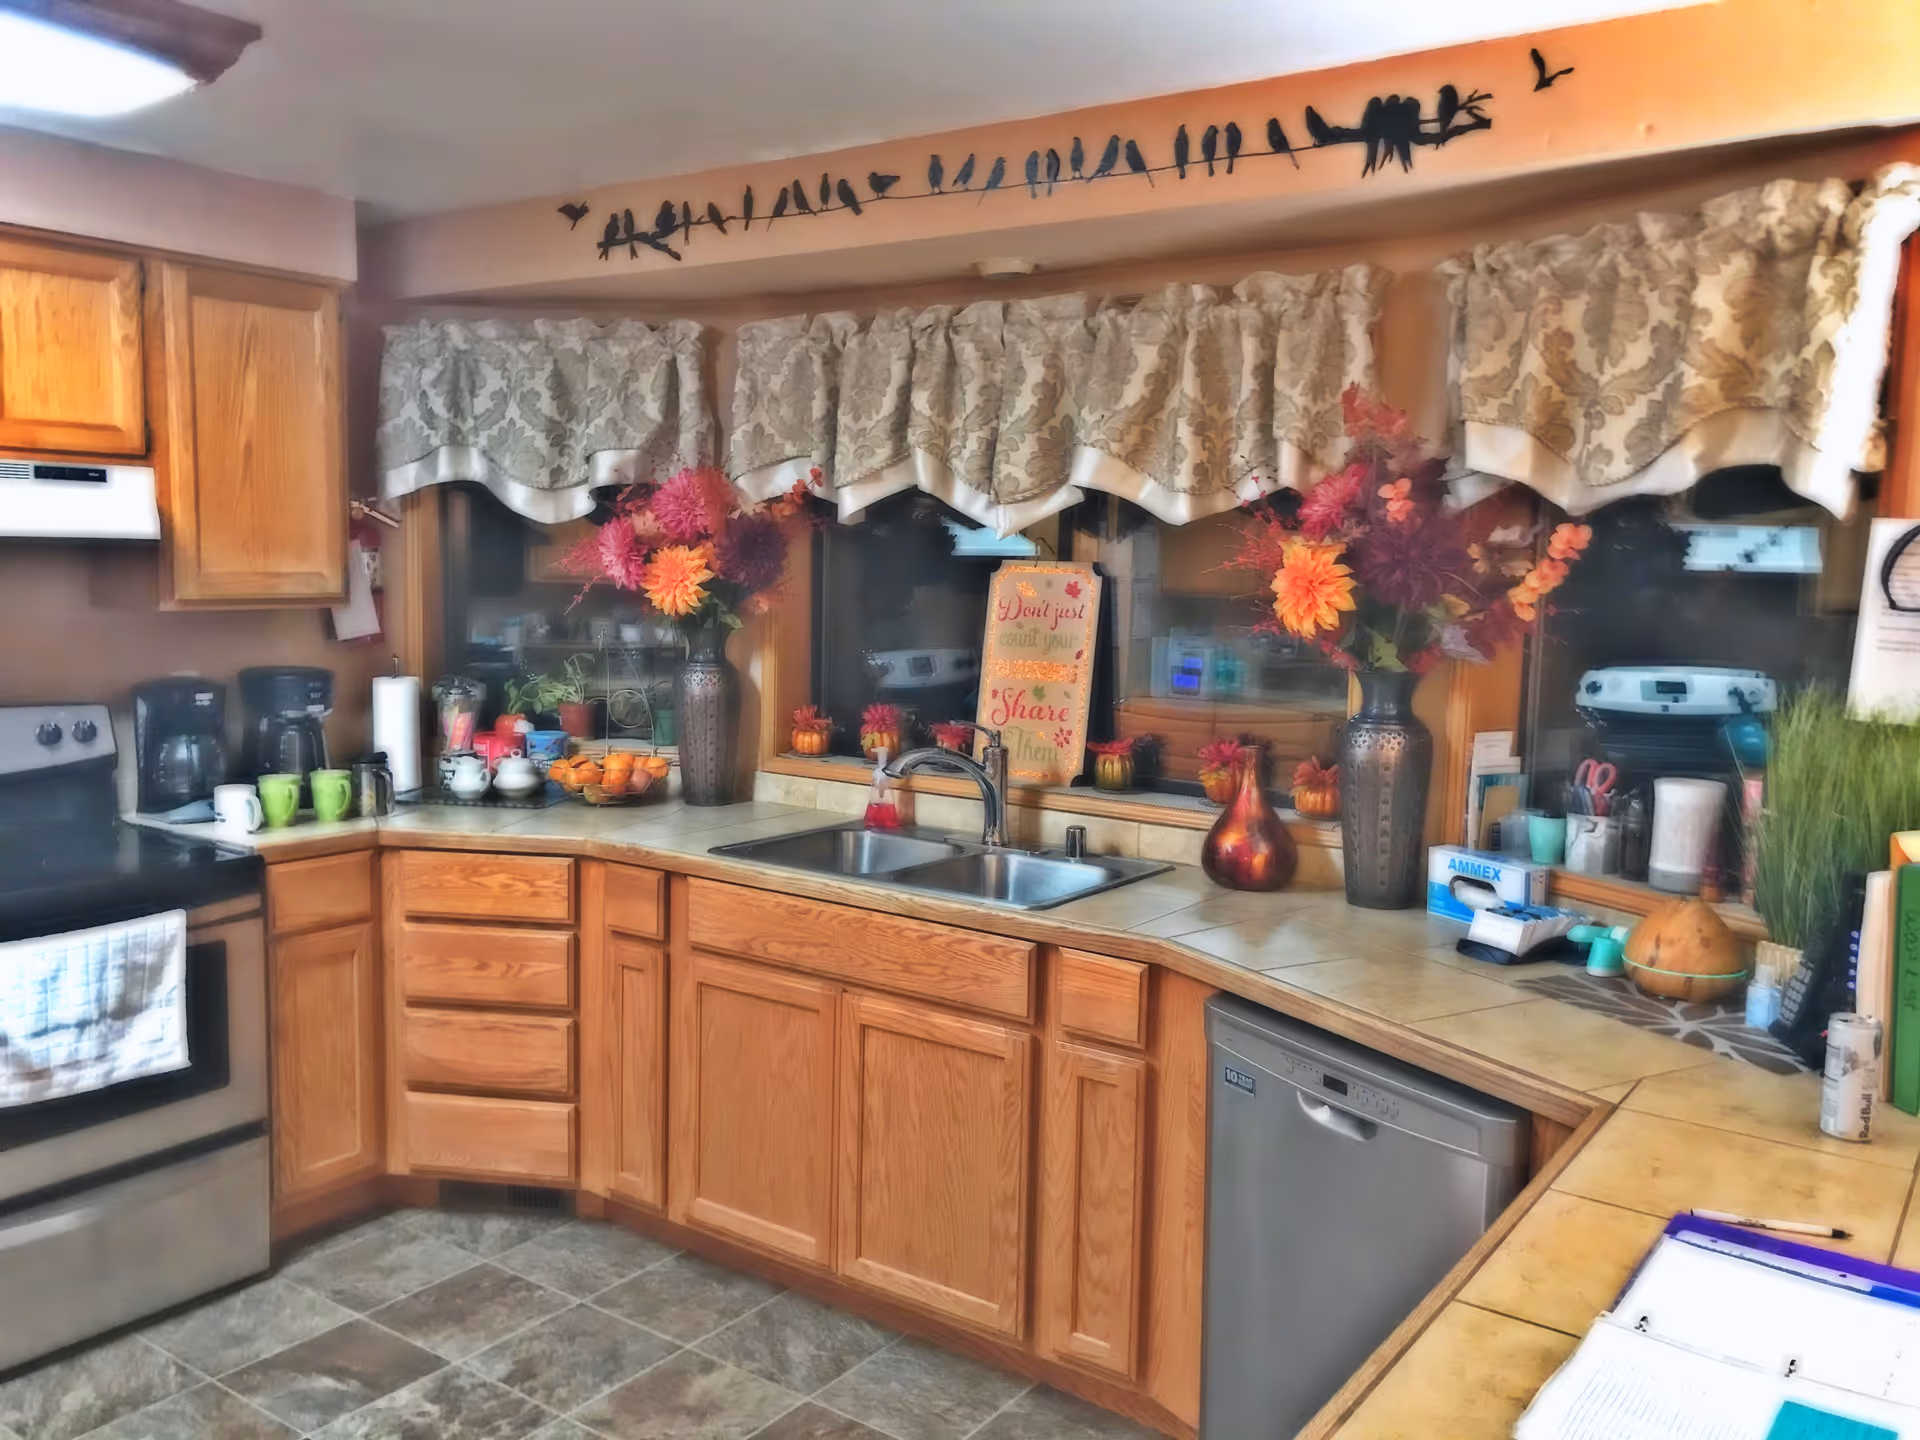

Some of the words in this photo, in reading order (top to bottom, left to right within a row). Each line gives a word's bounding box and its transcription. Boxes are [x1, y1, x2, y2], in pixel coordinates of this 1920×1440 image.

[998, 594, 1050, 621] Don't
[1050, 602, 1087, 631] just
[1000, 627, 1041, 648] count
[1043, 632, 1078, 655] your
[991, 687, 1070, 726] Share
[1001, 726, 1059, 762] Them
[1447, 857, 1502, 882] AMMEX
[1861, 1093, 1873, 1115] Bull
